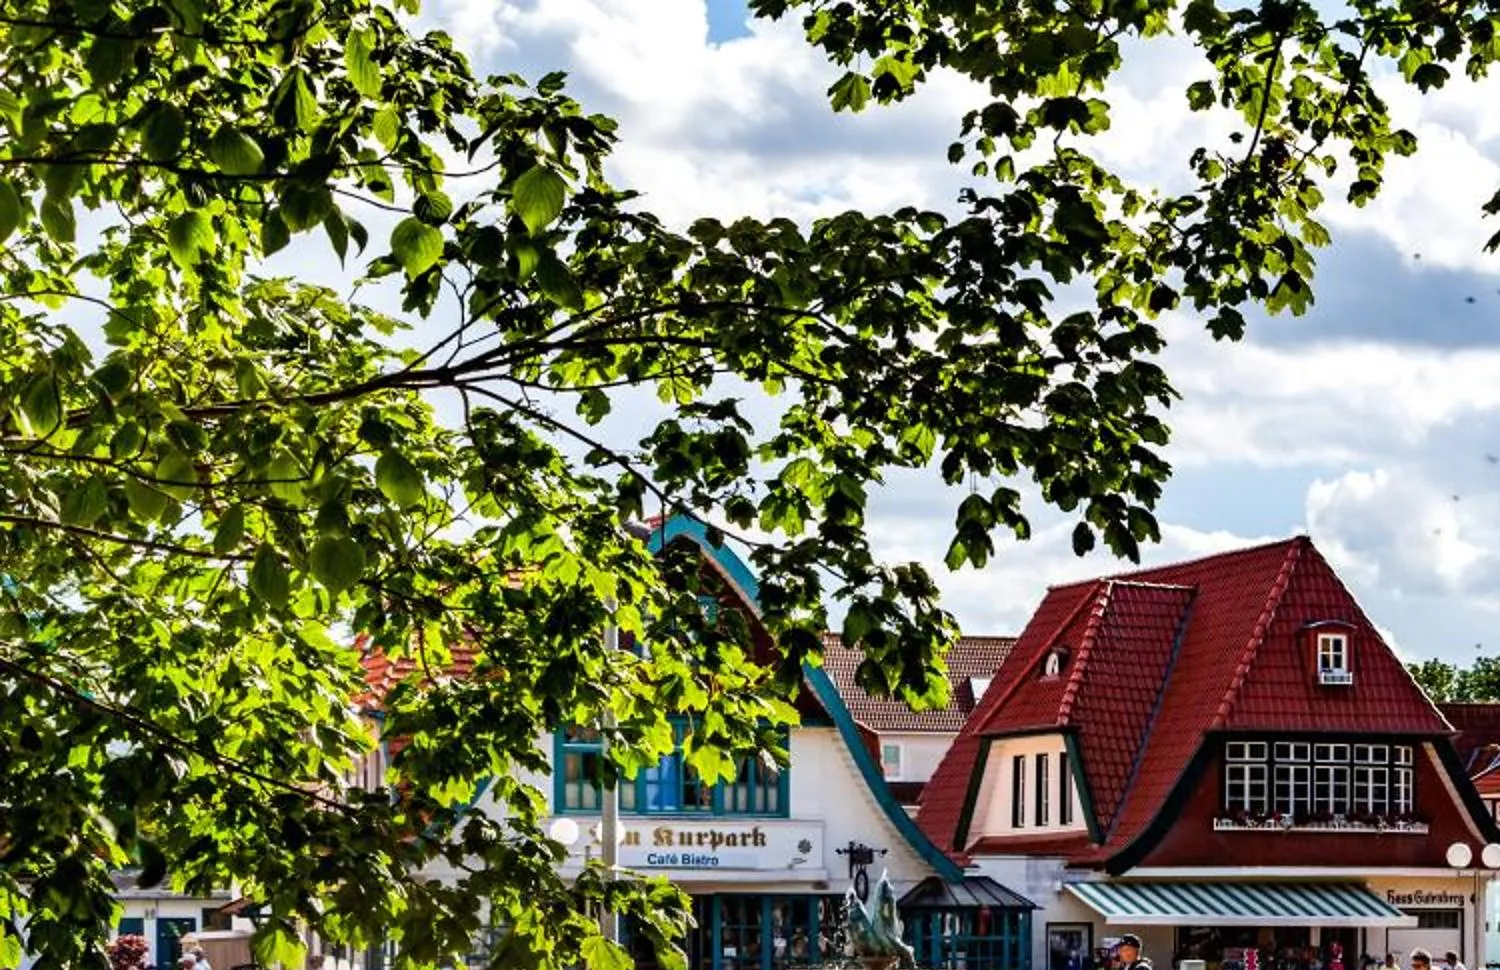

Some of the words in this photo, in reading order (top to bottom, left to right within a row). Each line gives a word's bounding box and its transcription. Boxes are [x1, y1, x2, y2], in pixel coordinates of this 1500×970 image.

[653, 827, 767, 852] Kurpark
[647, 852, 679, 866] Café
[681, 852, 719, 866] Bistro
